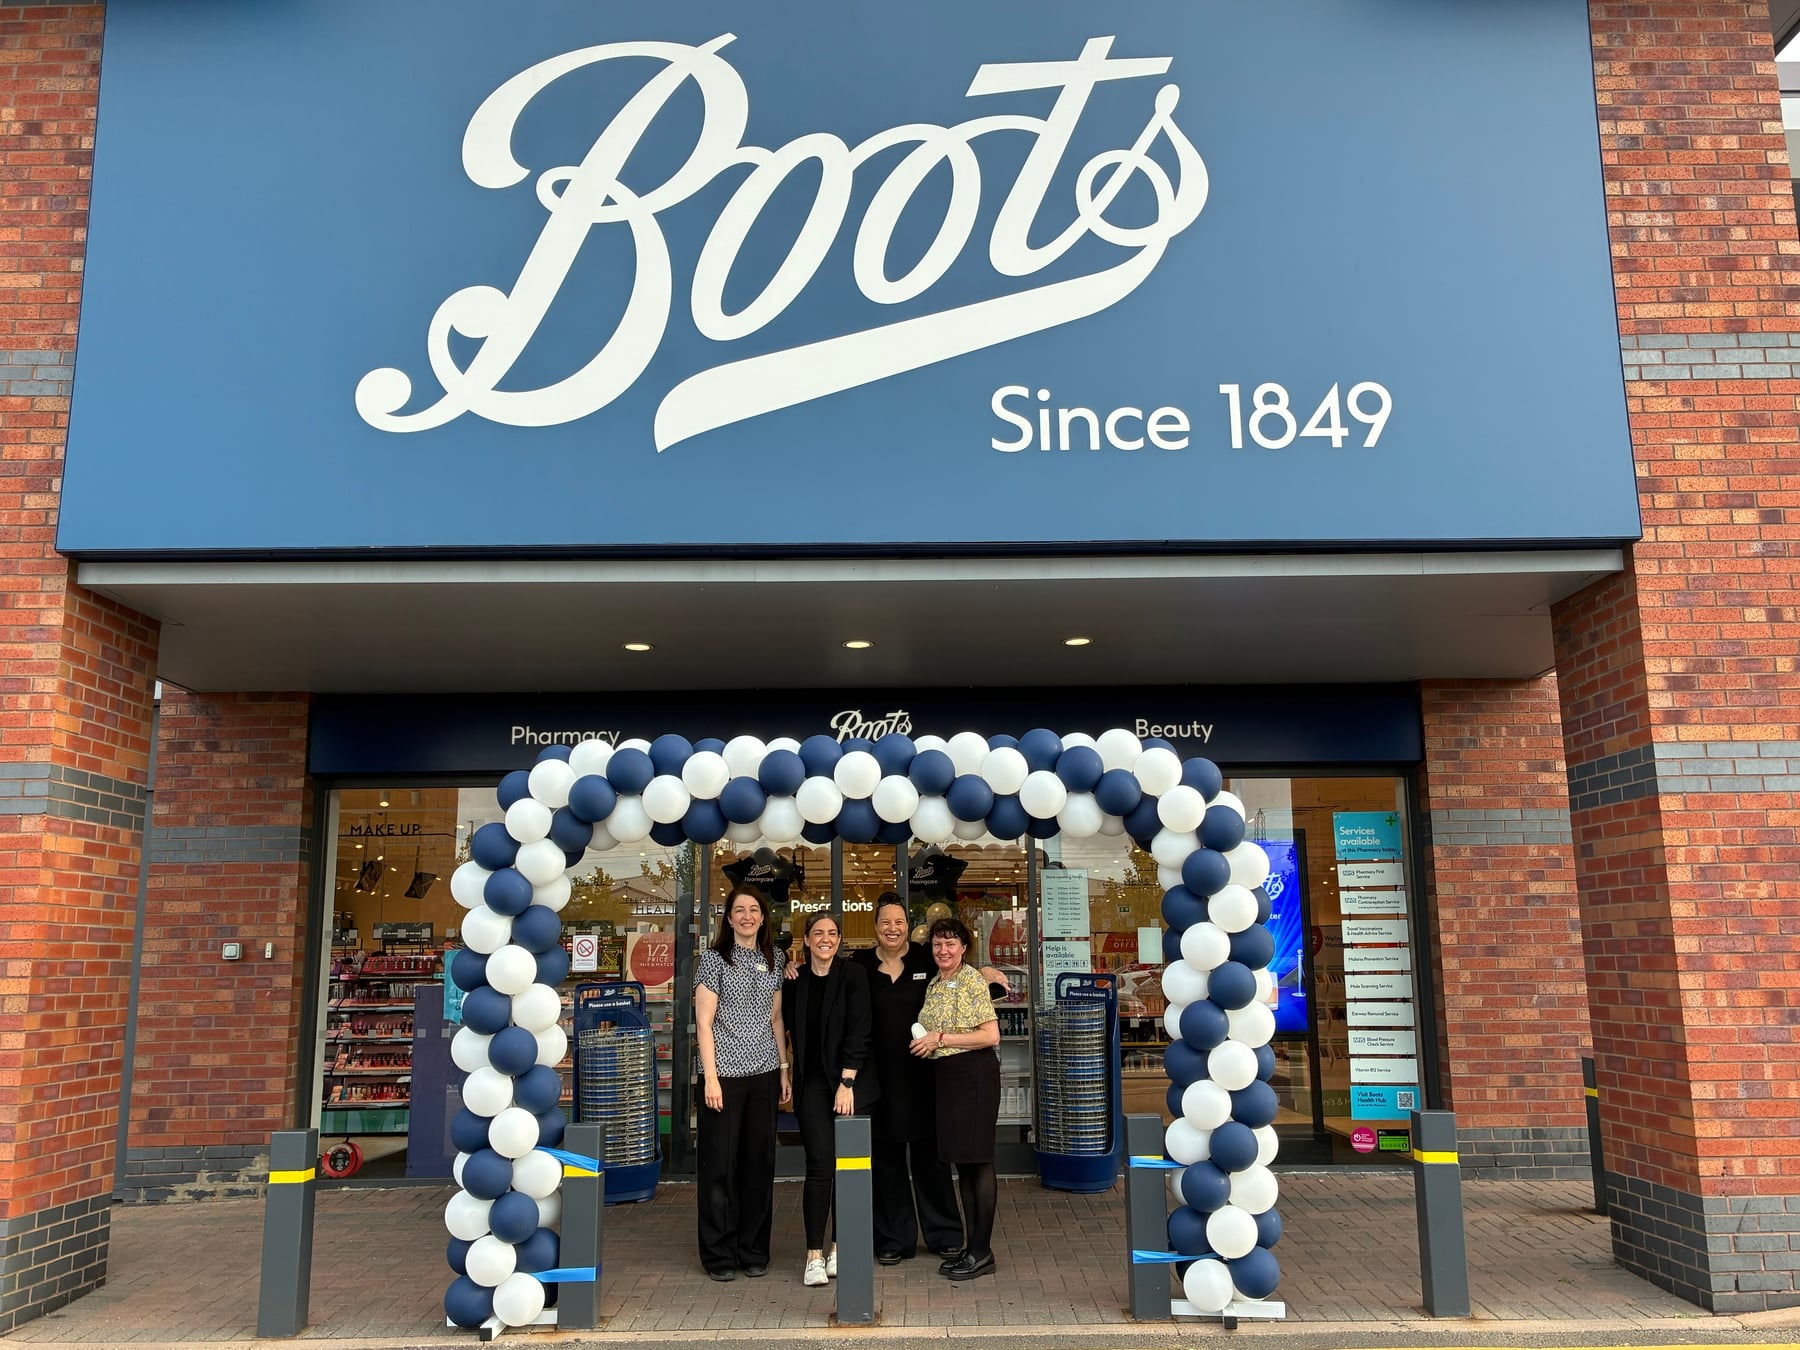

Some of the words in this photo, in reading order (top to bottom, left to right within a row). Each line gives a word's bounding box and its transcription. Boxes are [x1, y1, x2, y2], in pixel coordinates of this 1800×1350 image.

[356, 33, 1208, 452] Boots
[991, 385, 1190, 453] Since
[1219, 382, 1393, 450] 1849
[831, 709, 914, 744] Boots
[1136, 718, 1213, 744] Beauty
[511, 726, 621, 747] Pharmacy
[350, 824, 395, 836] MAKE
[400, 824, 421, 836] UP
[1339, 826, 1376, 836] Services
[1340, 836, 1381, 846] available
[748, 864, 771, 877] Boots
[912, 866, 935, 879] Boots
[790, 899, 874, 913] Prescrtions
[647, 943, 669, 957] 1/2
